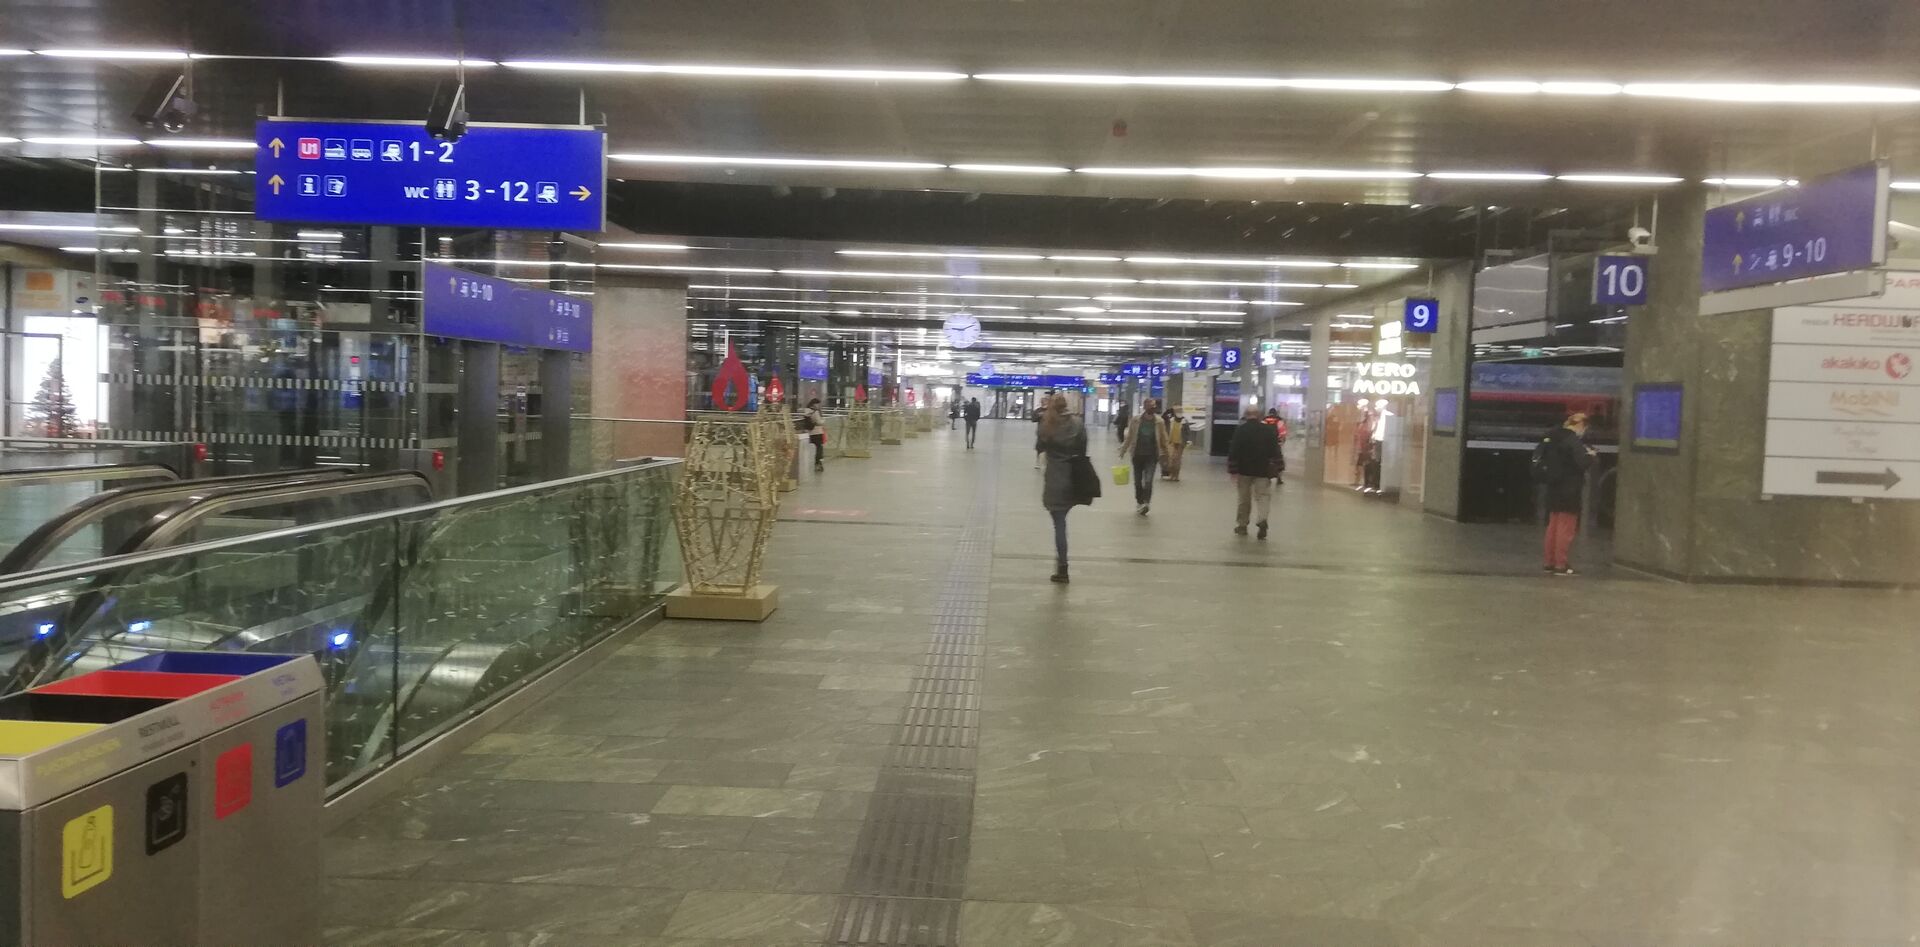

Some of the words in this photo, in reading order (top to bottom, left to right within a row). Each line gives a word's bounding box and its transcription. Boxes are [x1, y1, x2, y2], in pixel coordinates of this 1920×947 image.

[1782, 237, 1827, 267] 9-10
[1602, 264, 1643, 297] 10
[1412, 304, 1431, 328] 9
[1193, 356, 1203, 368] 7
[1225, 350, 1237, 363] 8
[1356, 362, 1416, 378] VERO
[1352, 379, 1420, 395] MODA
